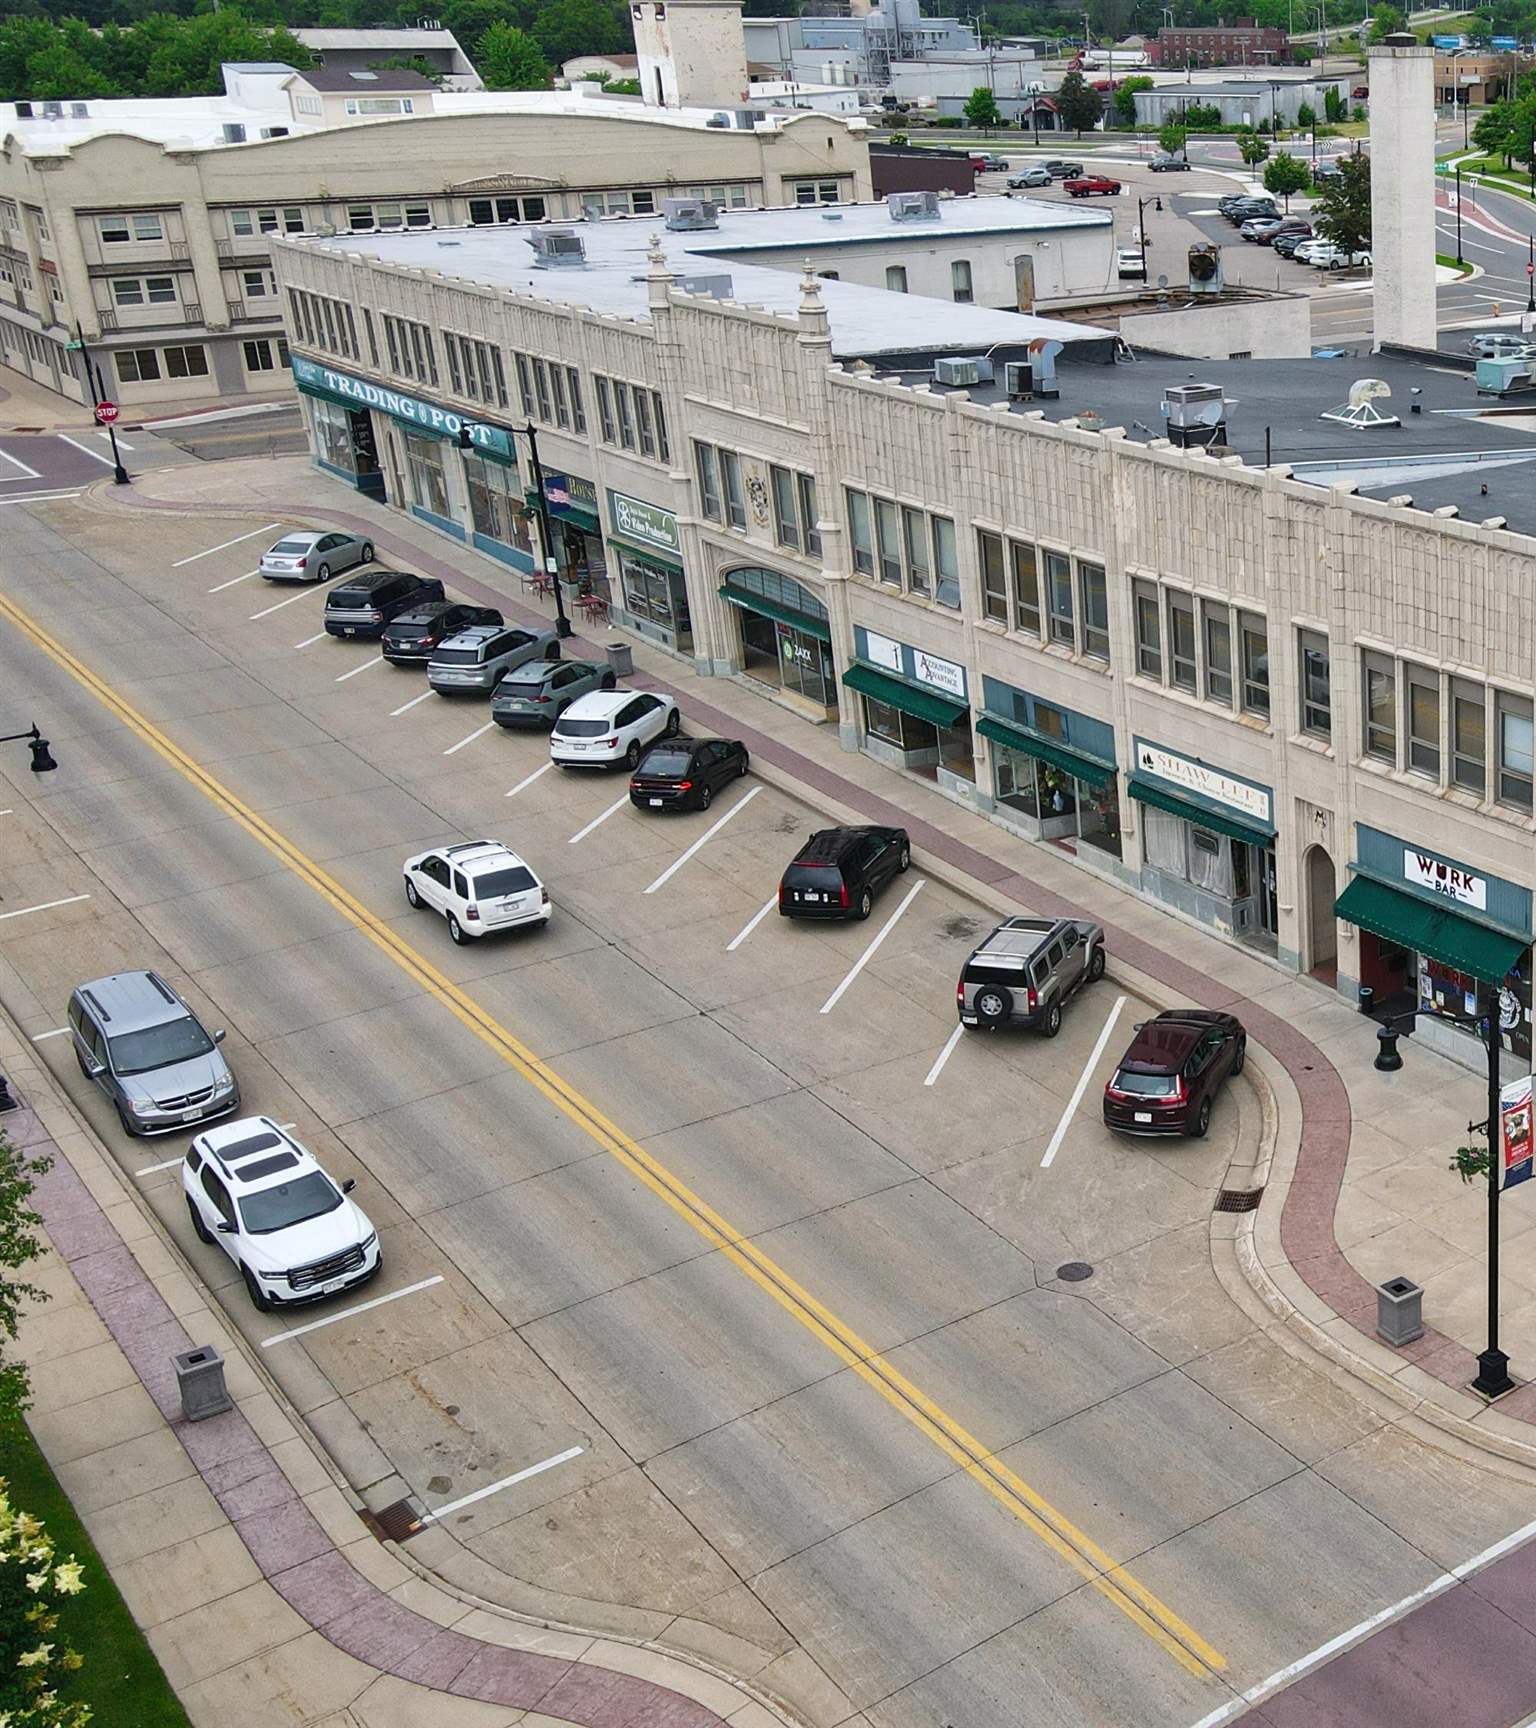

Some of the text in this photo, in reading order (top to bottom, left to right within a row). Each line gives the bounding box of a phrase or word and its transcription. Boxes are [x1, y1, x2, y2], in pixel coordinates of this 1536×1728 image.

[97, 407, 117, 416] STOP
[323, 371, 492, 445] TRADING POST
[1434, 880, 1457, 898] BAR
